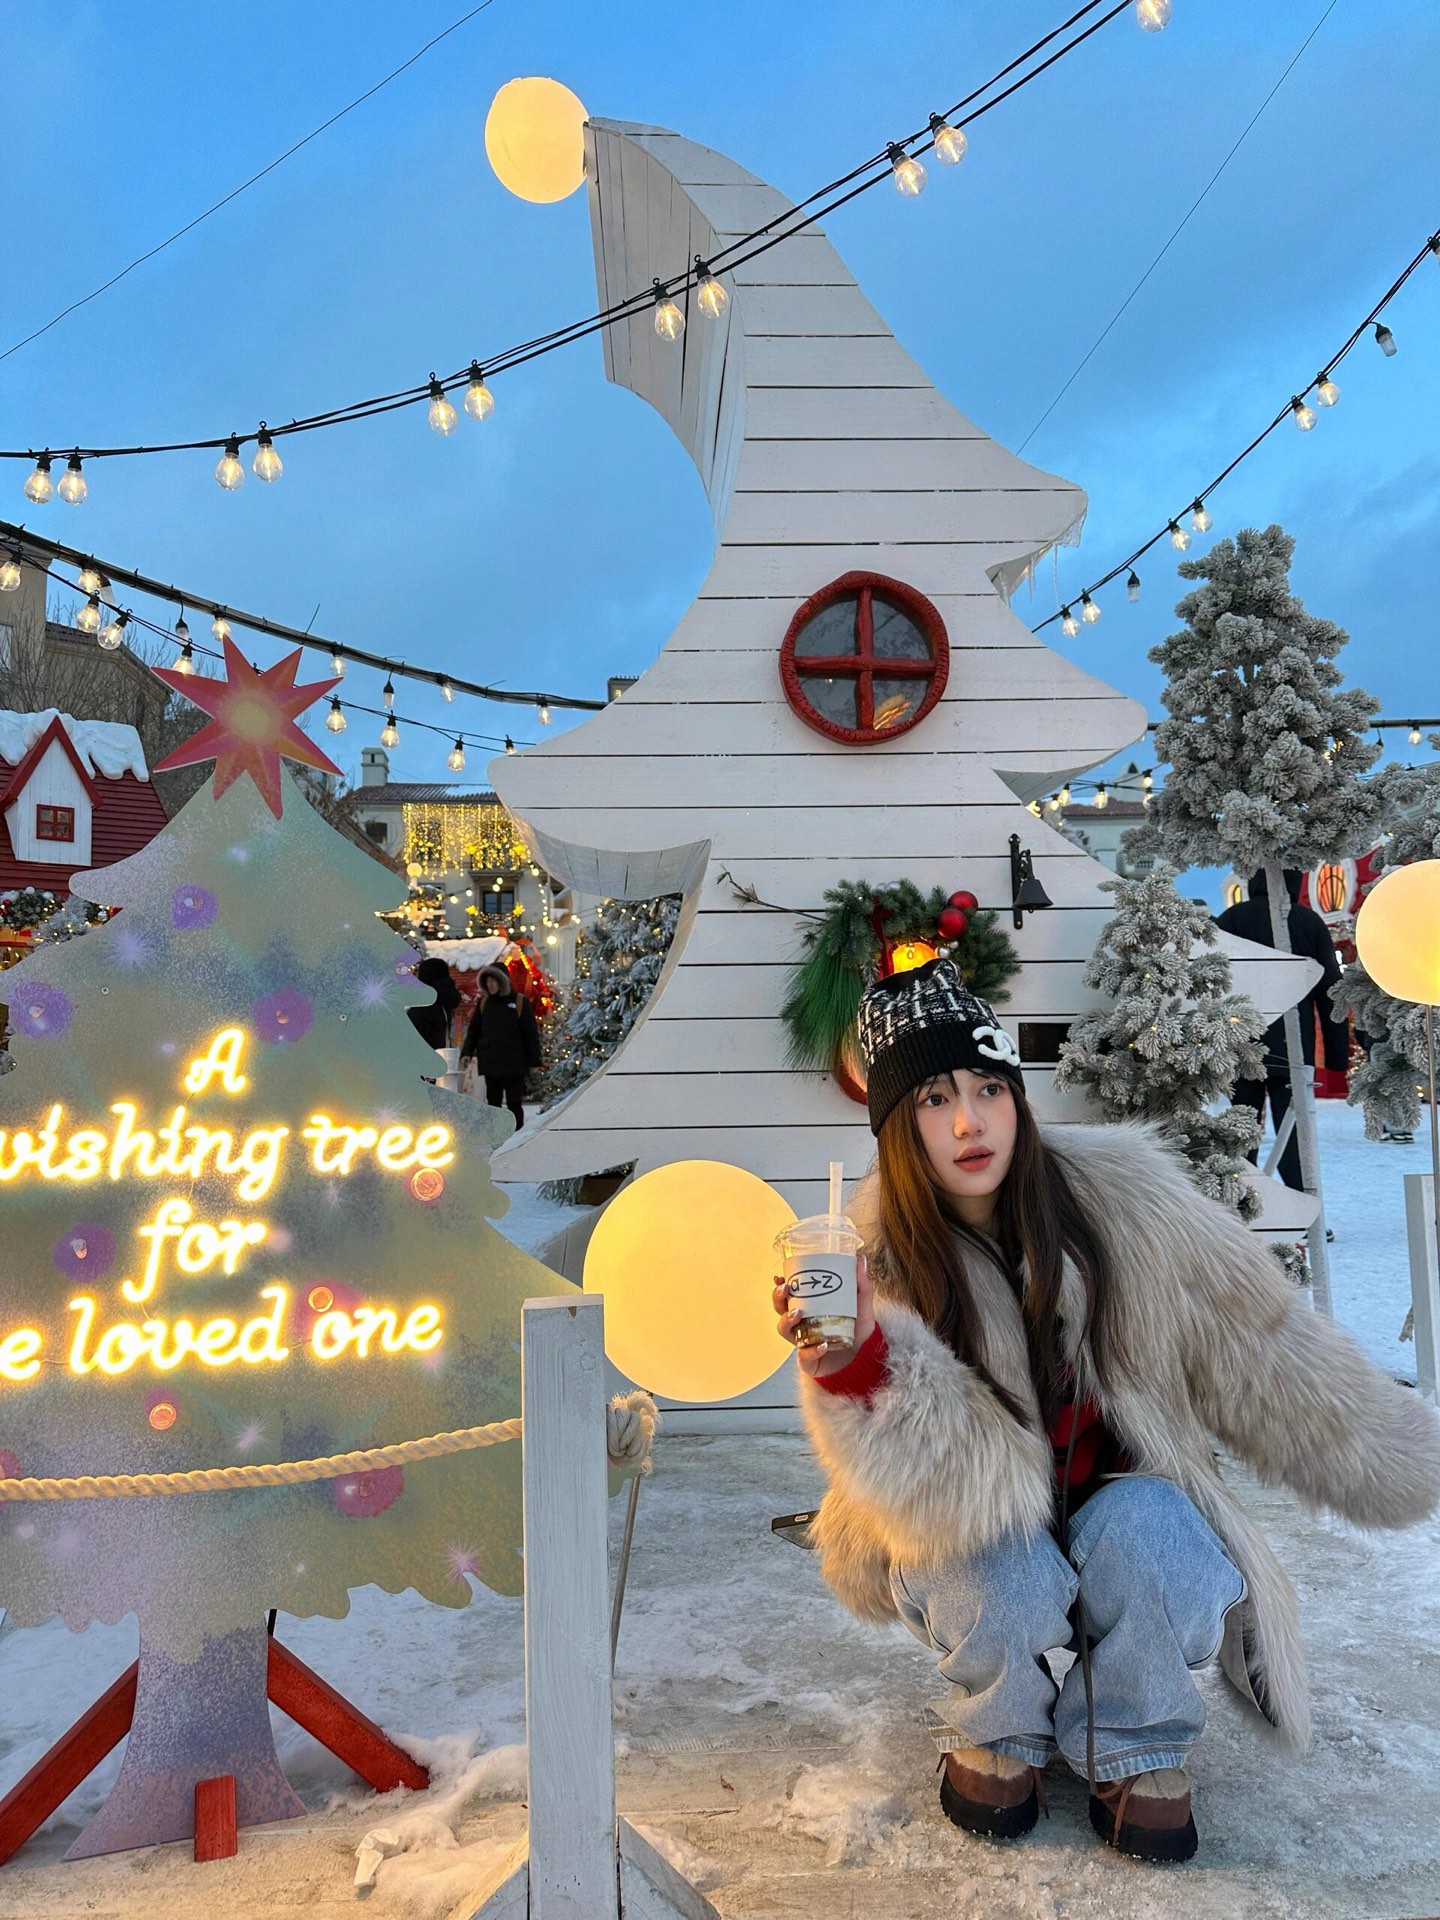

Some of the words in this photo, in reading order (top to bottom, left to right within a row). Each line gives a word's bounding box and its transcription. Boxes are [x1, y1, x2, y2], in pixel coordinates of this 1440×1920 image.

[184, 1028, 247, 1094] A
[303, 1114, 454, 1175] tree
[121, 1197, 267, 1304] for
[68, 1285, 289, 1375] loved
[311, 1304, 443, 1360] one
